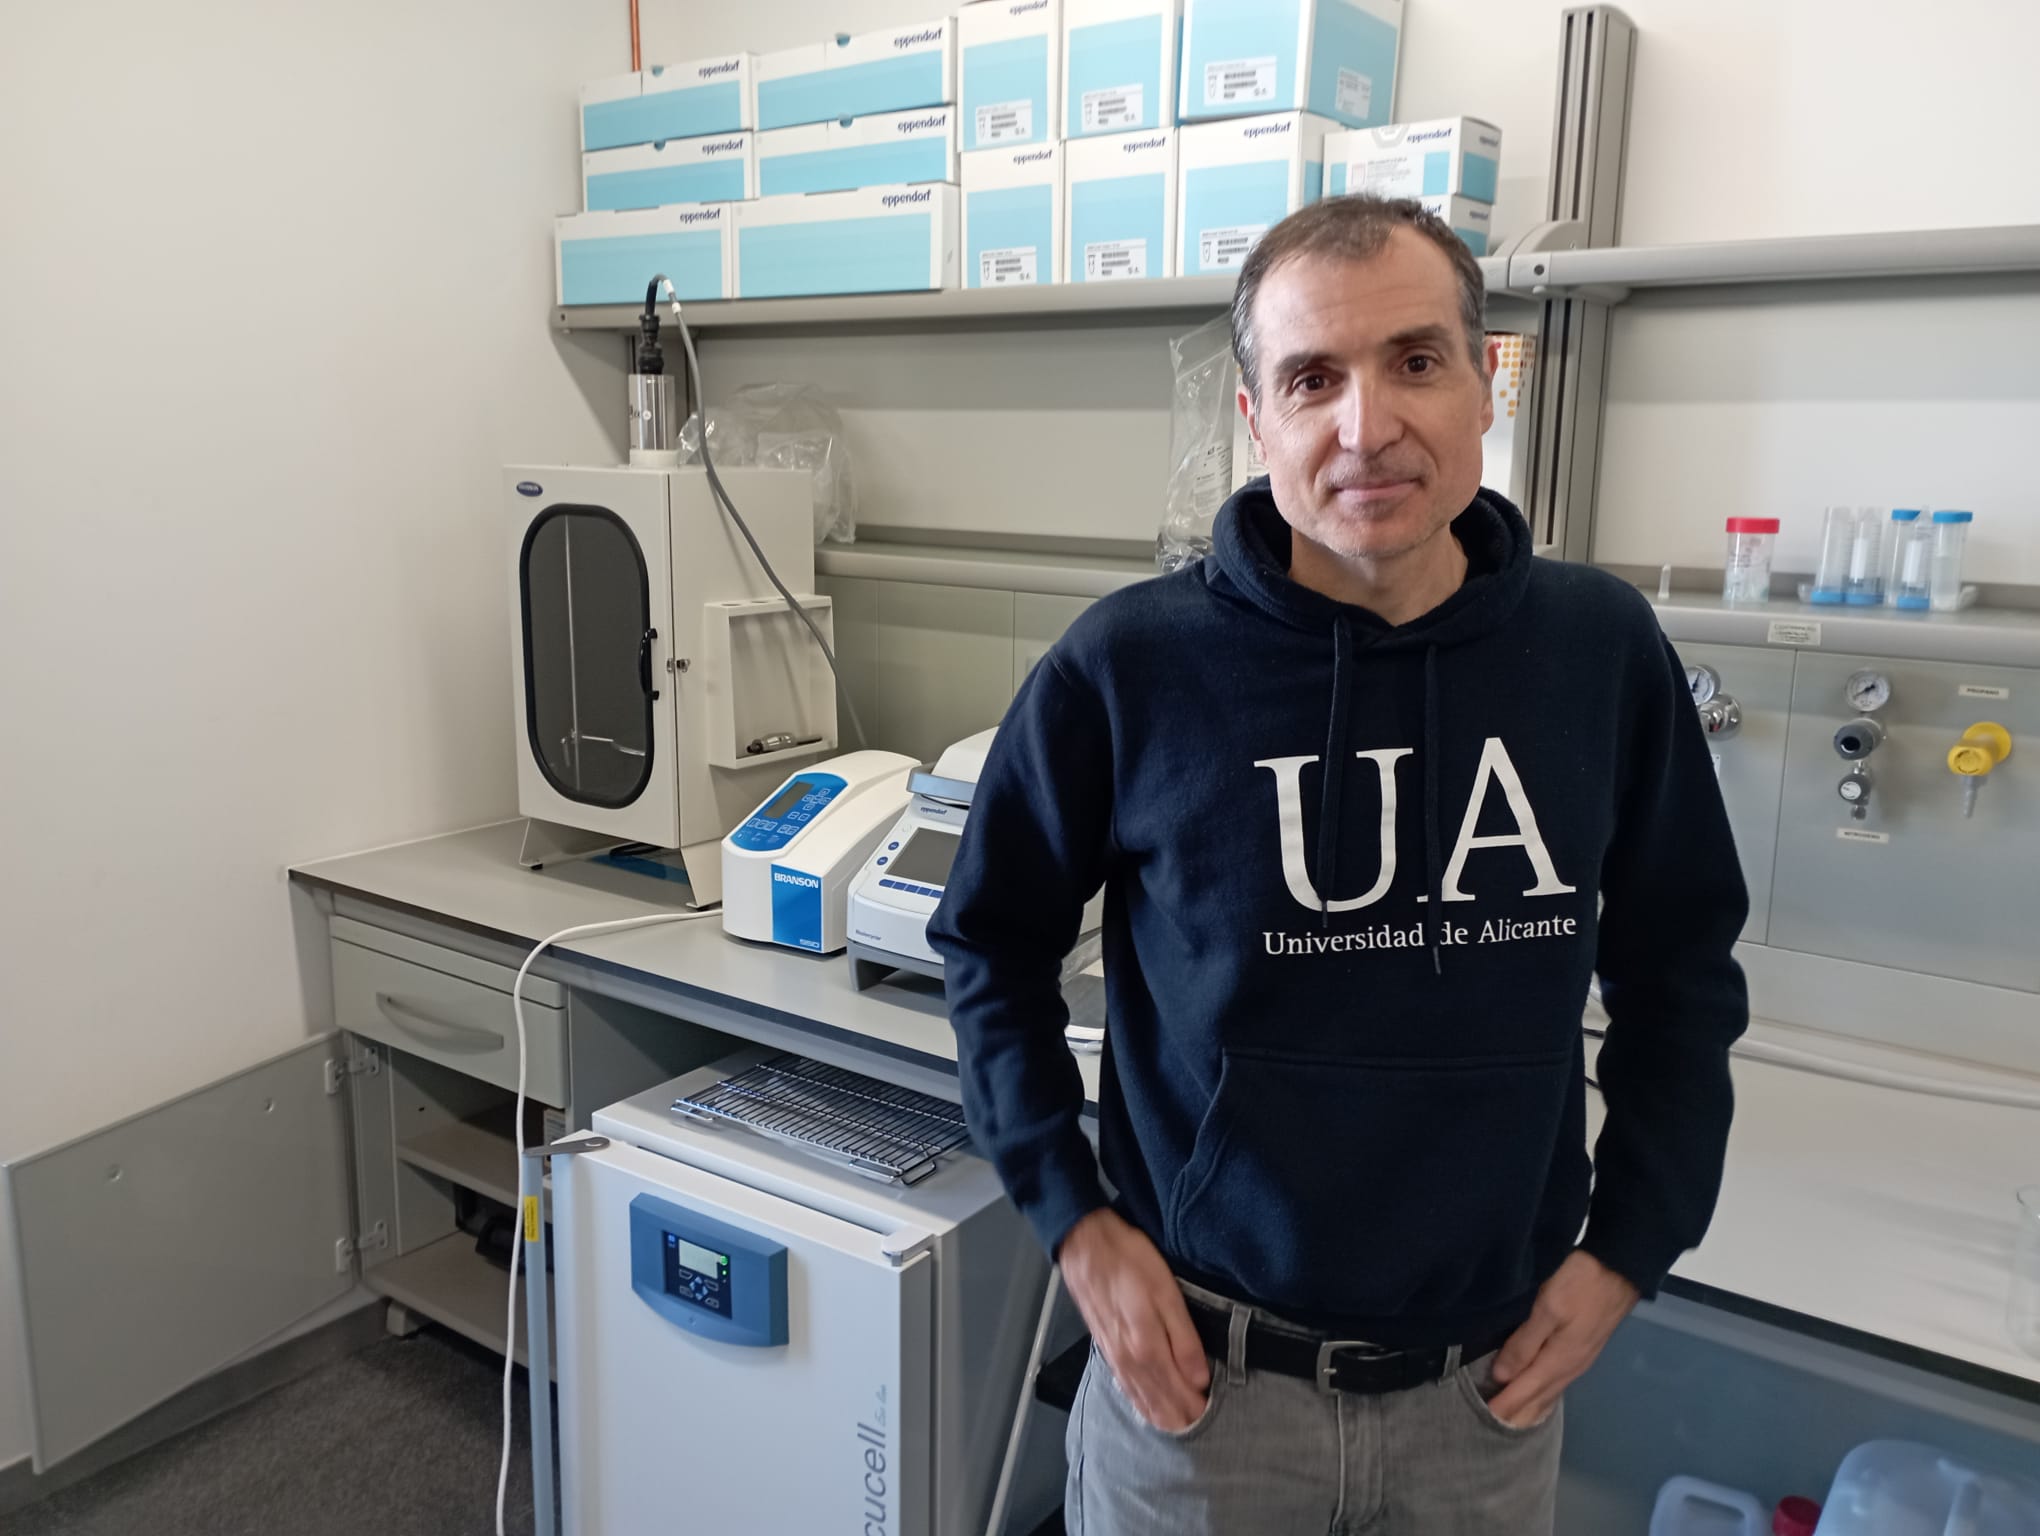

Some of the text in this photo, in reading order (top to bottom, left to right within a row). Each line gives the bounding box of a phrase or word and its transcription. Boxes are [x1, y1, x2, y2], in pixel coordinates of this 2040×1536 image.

[893, 28, 942, 48] eppendorf
[698, 61, 740, 78] eppendorf
[897, 115, 946, 132] eppendorf
[1243, 121, 1291, 138] eppendorf
[702, 138, 744, 155] eppendorf
[1123, 136, 1167, 152] eppendorf
[1012, 149, 1053, 165] eppendorf
[881, 190, 932, 207] eppendorf
[679, 208, 721, 223] eppendorf
[774, 873, 819, 888] BRANSON
[1263, 914, 1577, 956] Universidad de Alicante
